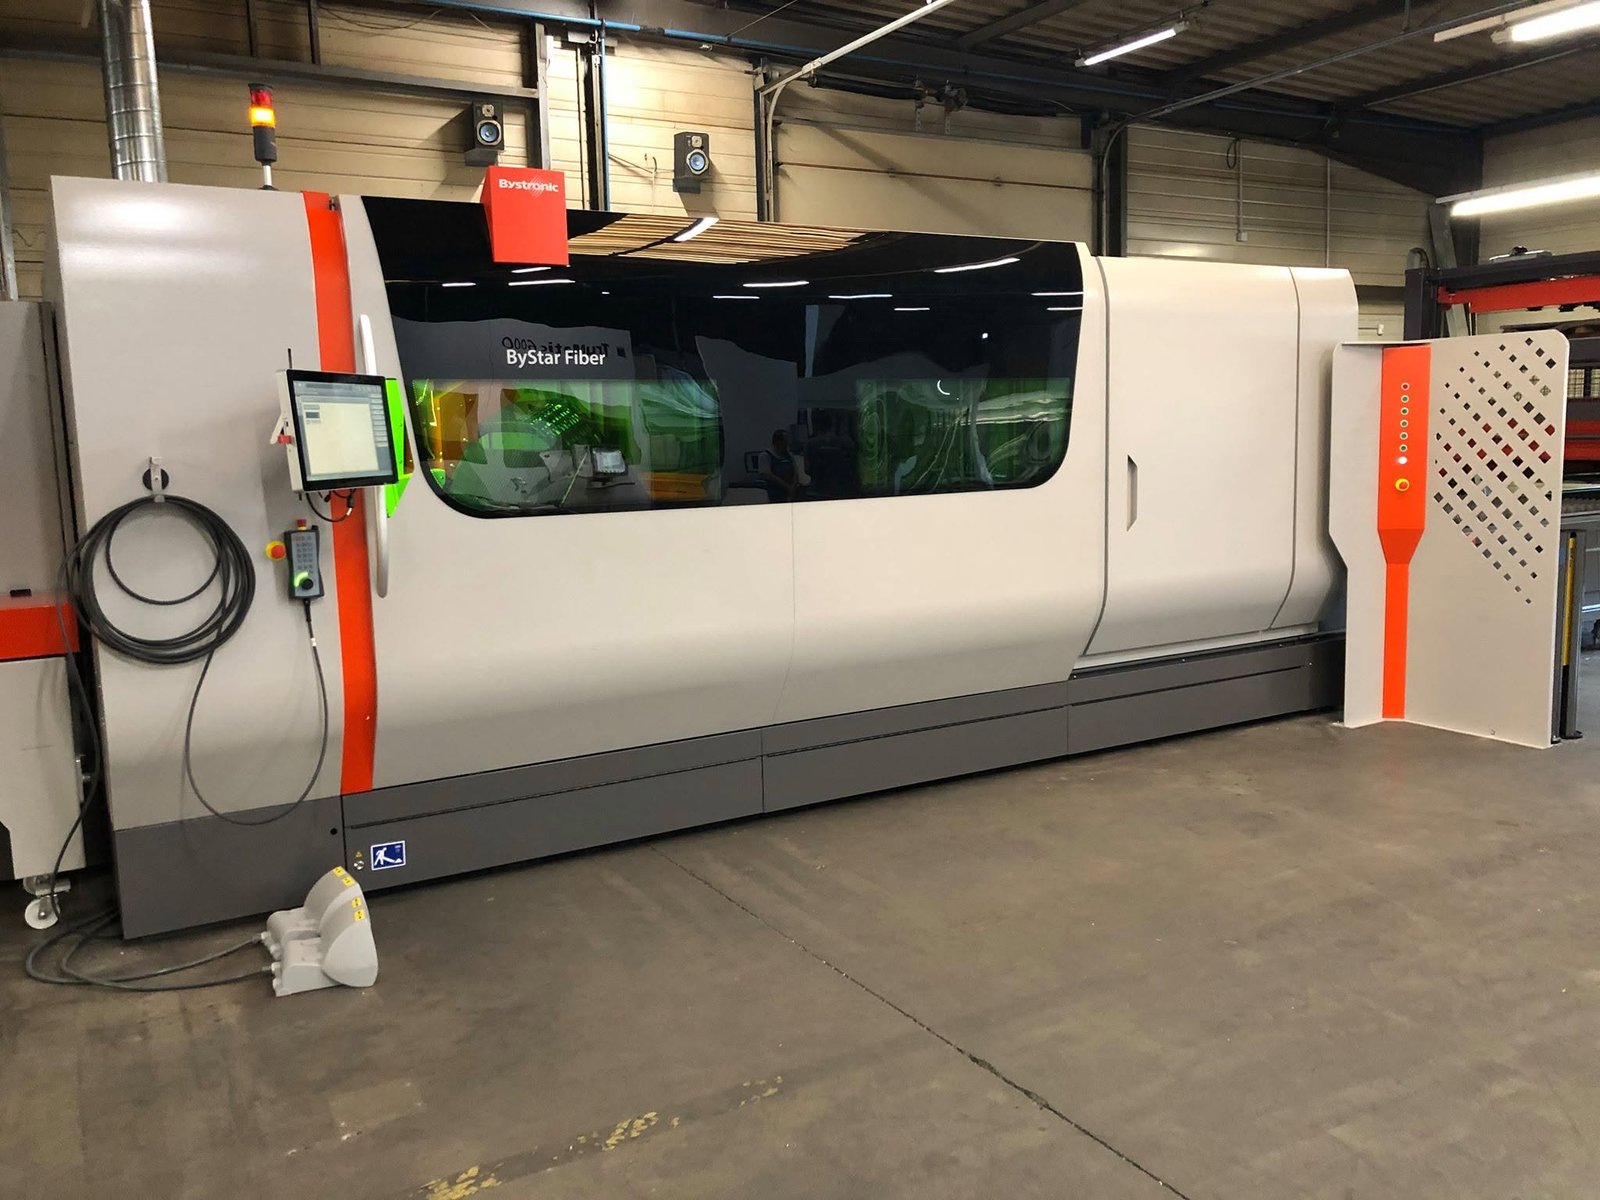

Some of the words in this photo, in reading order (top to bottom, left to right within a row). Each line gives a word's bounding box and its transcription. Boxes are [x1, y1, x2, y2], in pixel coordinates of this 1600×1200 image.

[499, 178, 559, 192] Bystronic
[506, 349, 560, 368] ByStar
[565, 350, 606, 365] Fiber
